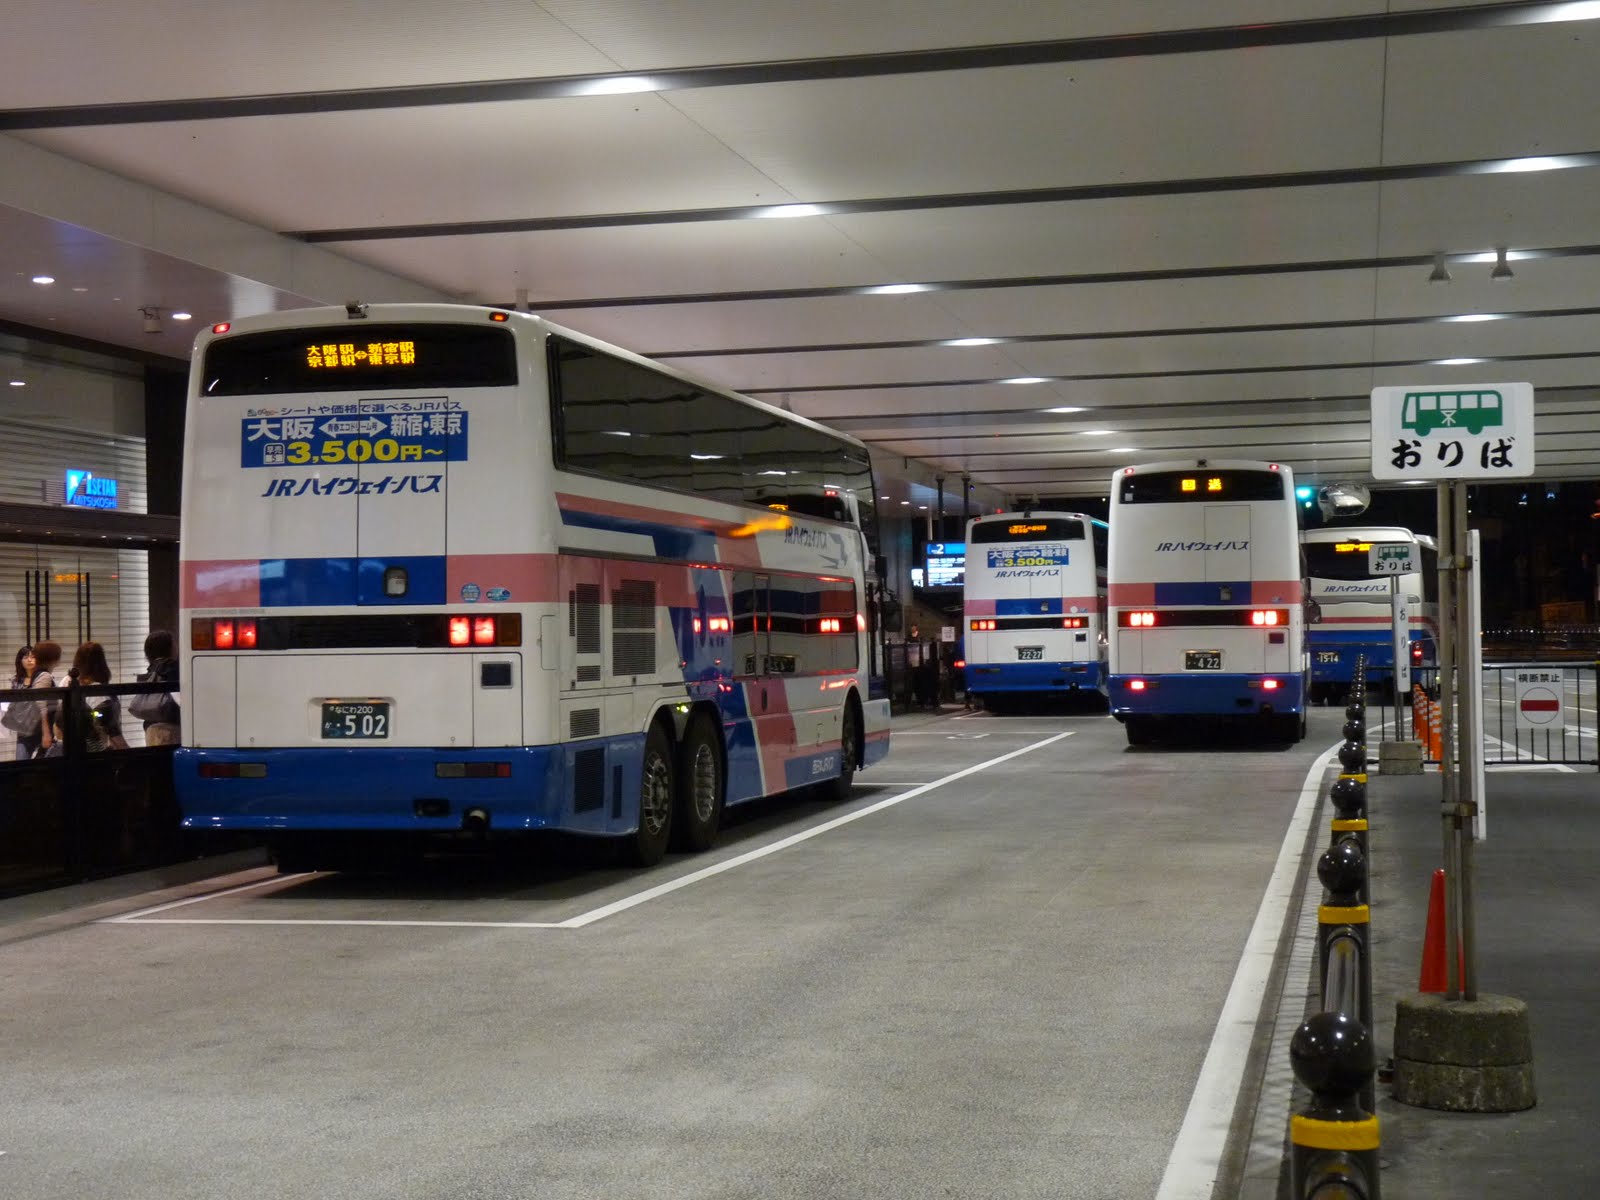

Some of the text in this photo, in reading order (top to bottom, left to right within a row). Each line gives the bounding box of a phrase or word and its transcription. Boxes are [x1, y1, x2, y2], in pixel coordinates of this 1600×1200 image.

[307, 342, 414, 355] 大阪駅 新宿駅
[307, 353, 415, 367] 京都駅 東京駅
[247, 418, 315, 442] 大阪
[390, 413, 462, 437] 新宿・東京
[1392, 436, 1515, 469] おりば
[1374, 560, 1413, 571] おりば
[1518, 673, 1561, 683] 横断禁止
